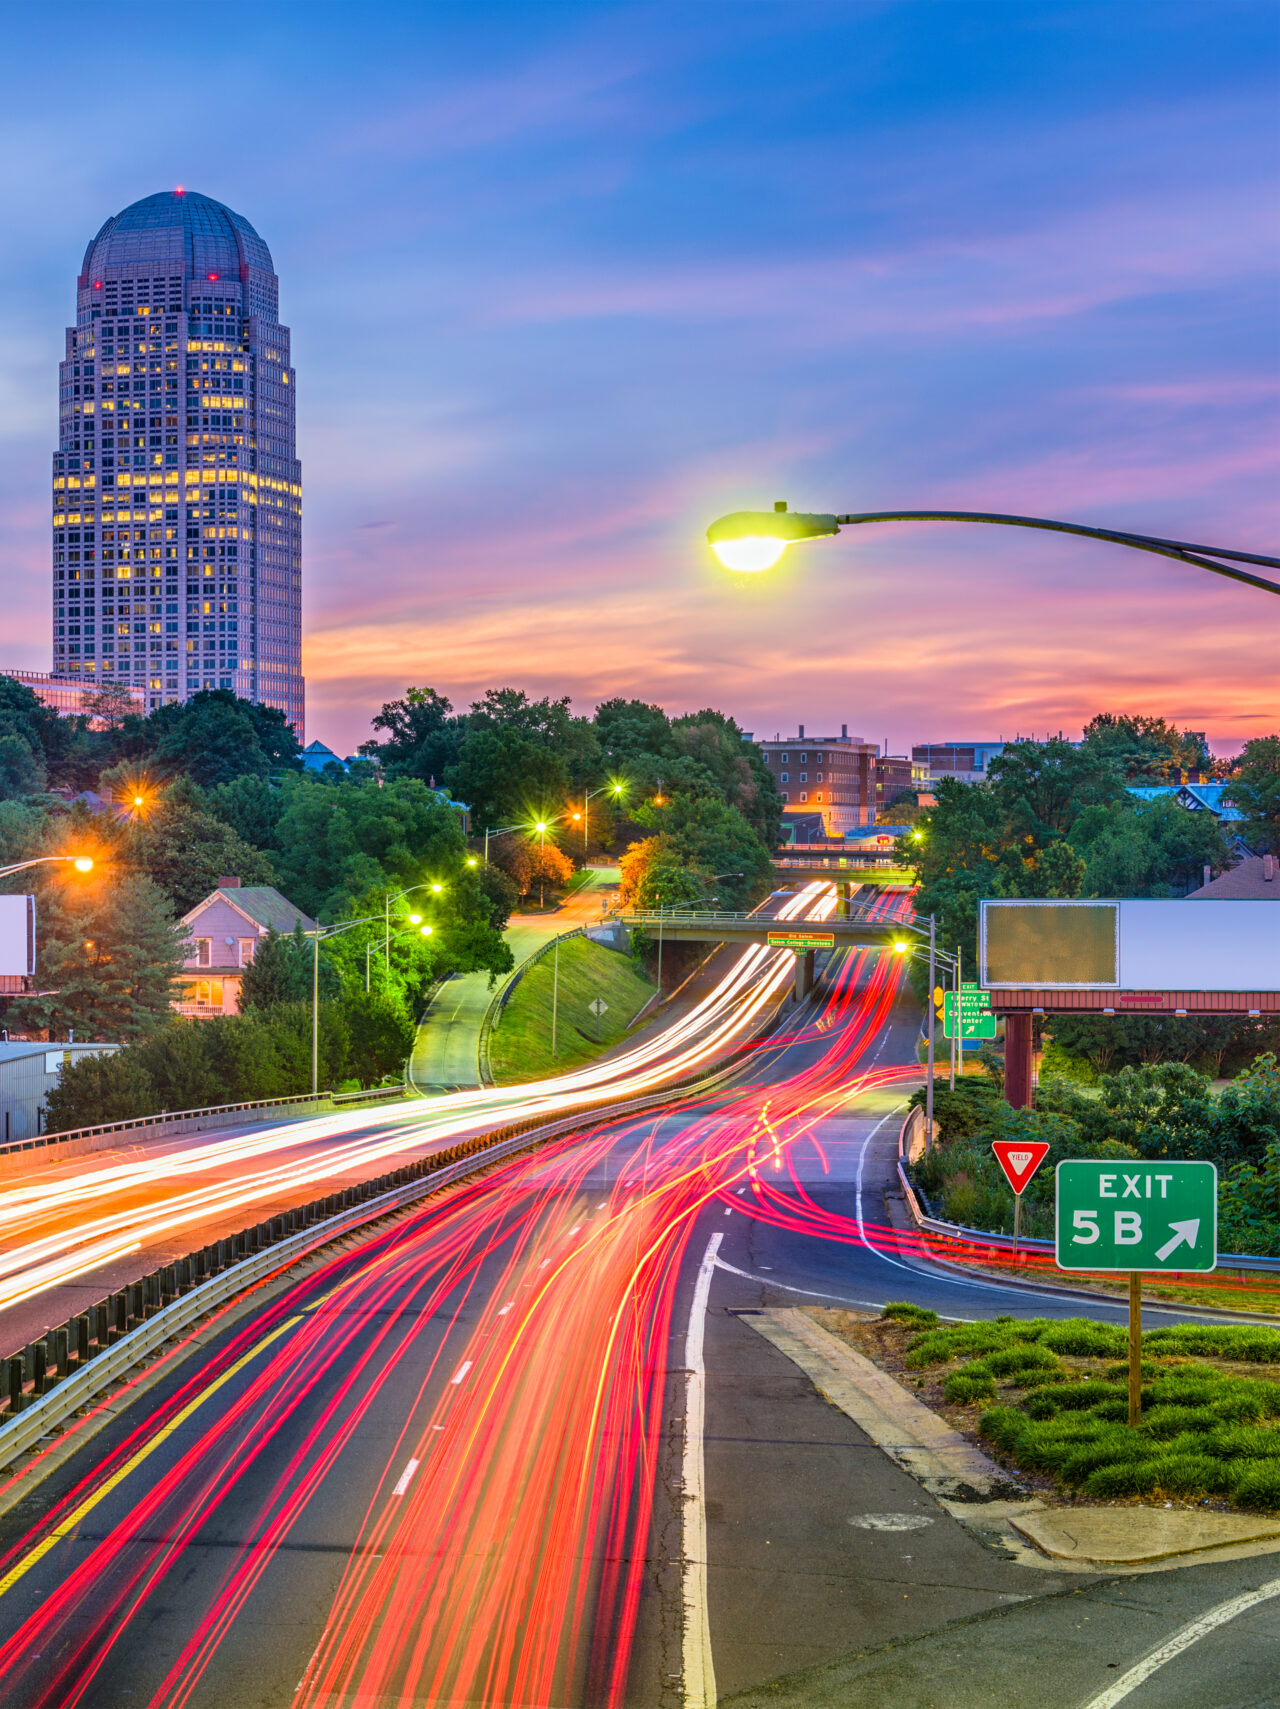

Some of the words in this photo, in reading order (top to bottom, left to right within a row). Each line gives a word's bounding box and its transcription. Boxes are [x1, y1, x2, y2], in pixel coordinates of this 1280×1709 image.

[1099, 1174, 1173, 1199] EXIT
[1071, 1210, 1100, 1245] 5
[1114, 1210, 1143, 1245] B
